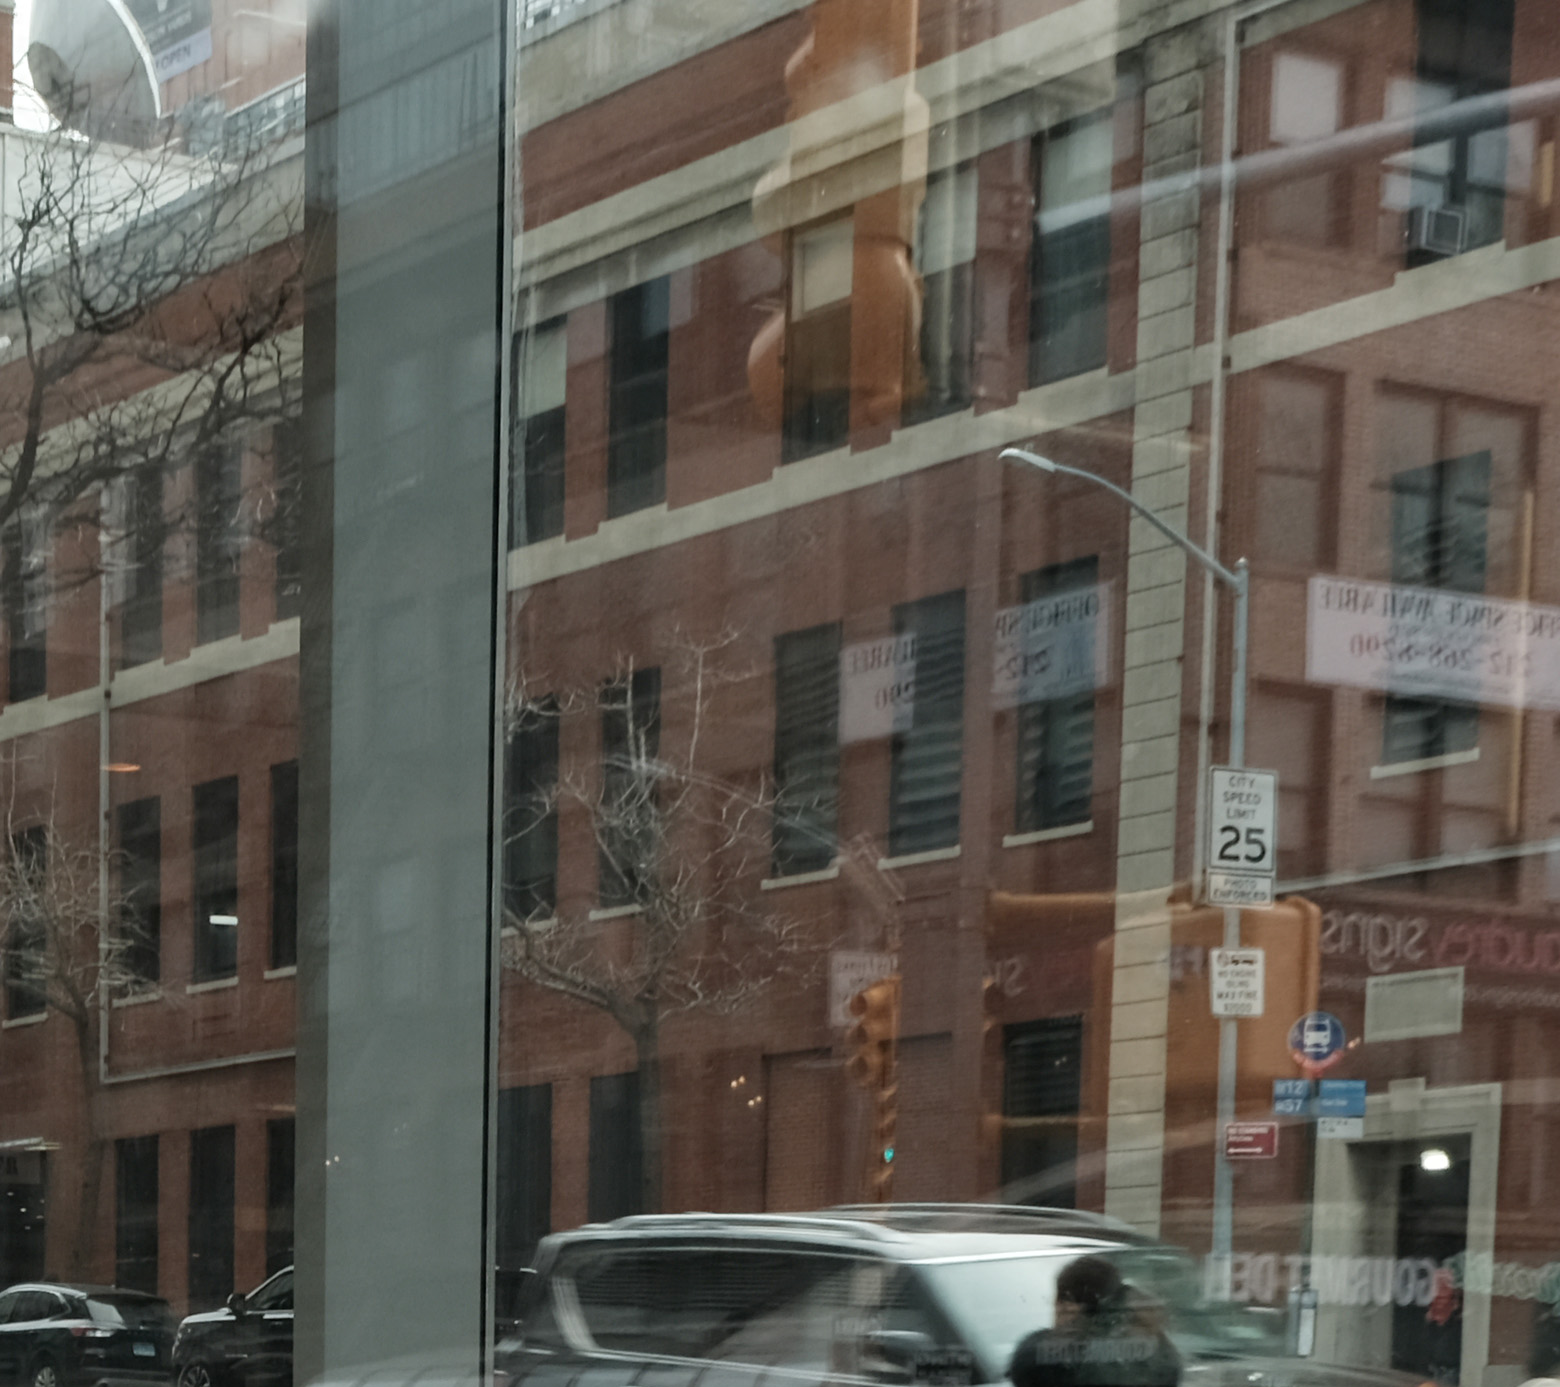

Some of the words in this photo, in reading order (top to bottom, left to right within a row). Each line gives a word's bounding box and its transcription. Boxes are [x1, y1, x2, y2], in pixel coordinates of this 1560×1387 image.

[1228, 776, 1256, 789] CITY
[1222, 791, 1262, 806] SPEED
[1226, 808, 1257, 821] LIMIT
[1218, 825, 1267, 863] 25
[1224, 878, 1258, 890] PHOTO
[1212, 888, 1268, 902] ENFORCED
